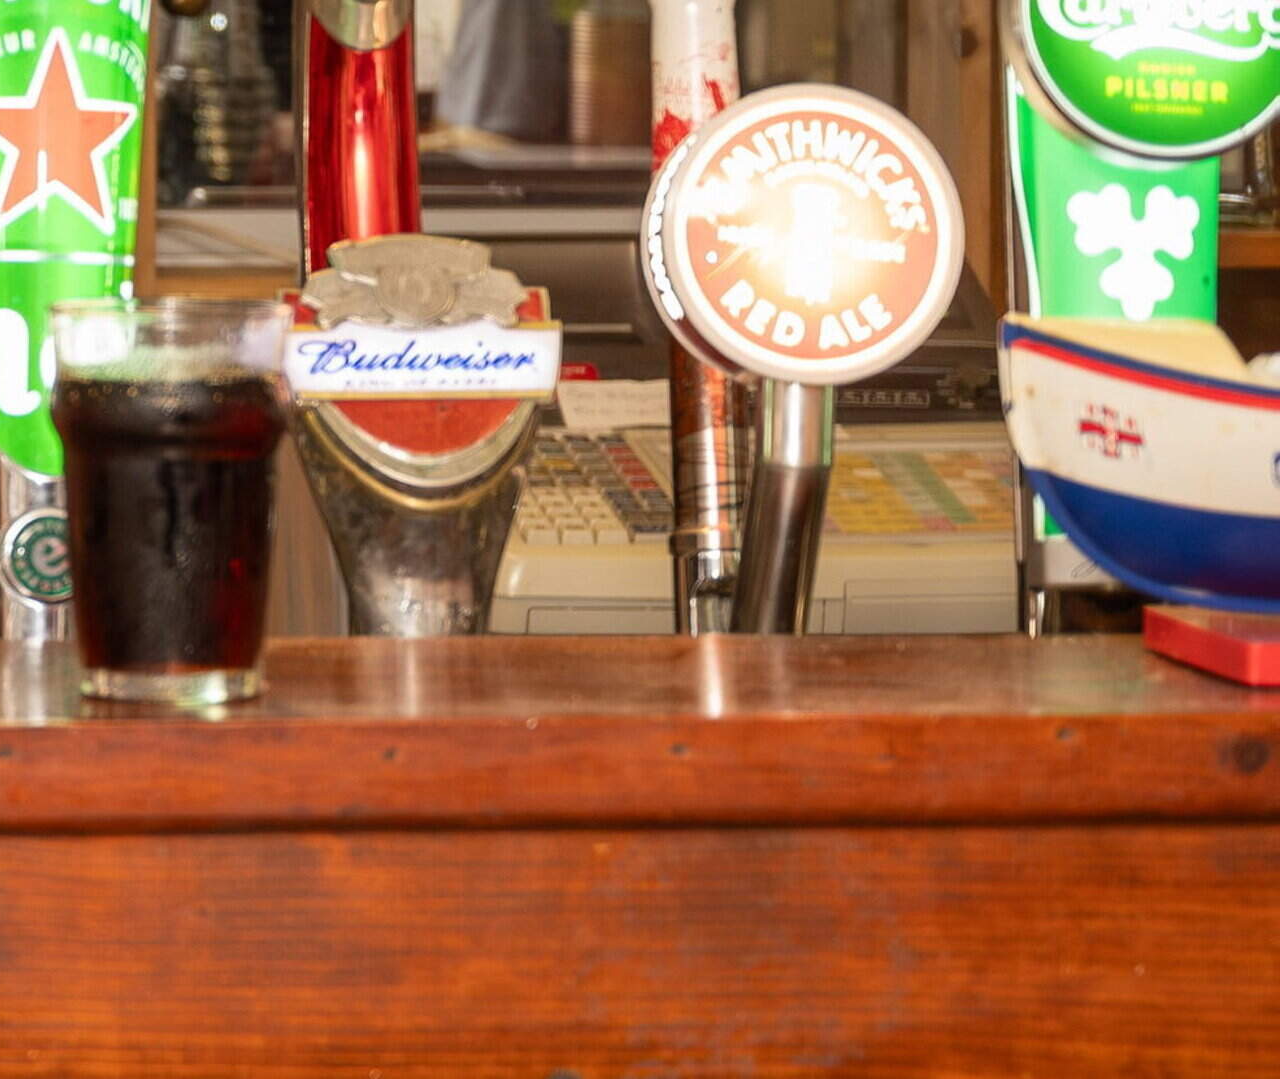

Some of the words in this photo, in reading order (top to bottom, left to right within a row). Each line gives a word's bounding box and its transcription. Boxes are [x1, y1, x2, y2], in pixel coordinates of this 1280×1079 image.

[1104, 75, 1230, 104] PILSNER
[719, 278, 807, 348] RED
[816, 292, 894, 352] ALE
[297, 339, 538, 375] Budweiser
